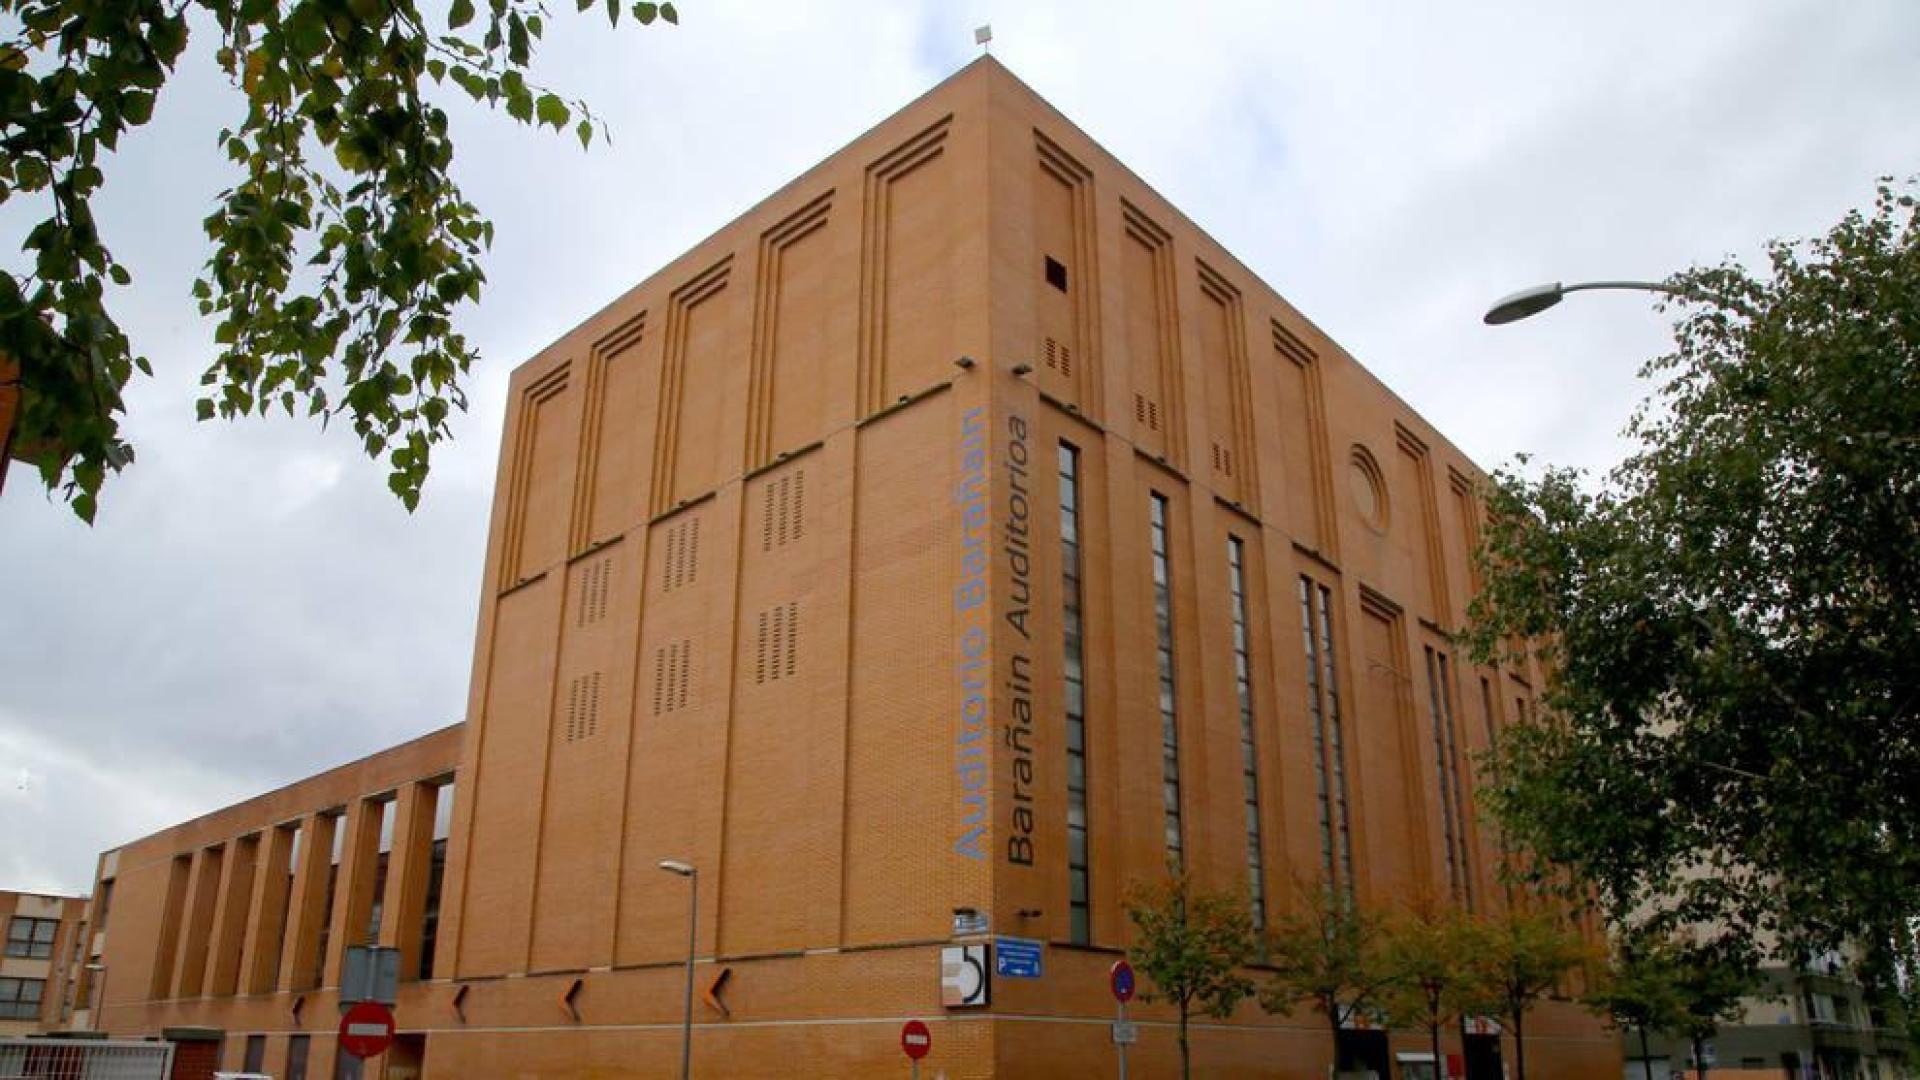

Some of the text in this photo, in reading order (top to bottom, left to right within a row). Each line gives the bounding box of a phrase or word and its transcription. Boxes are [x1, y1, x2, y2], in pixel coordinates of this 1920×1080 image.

[955, 626, 986, 860] Auditorio
[1005, 414, 1033, 867] Barañain Auditorioa
